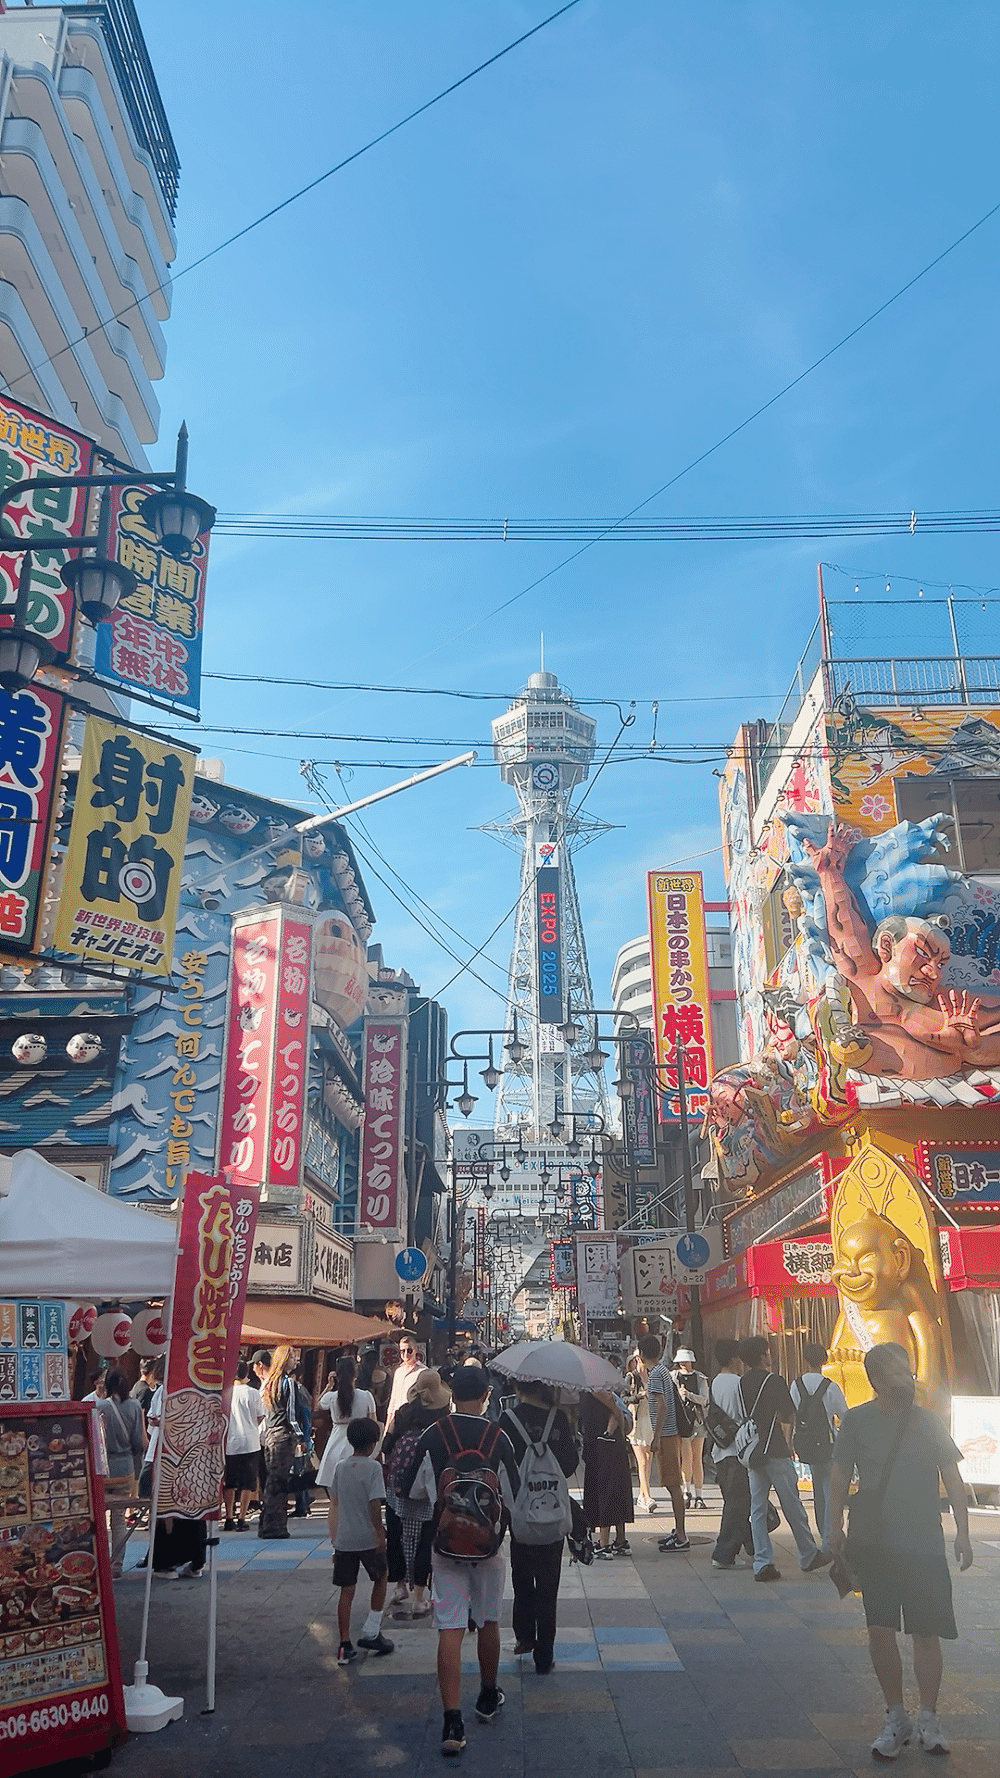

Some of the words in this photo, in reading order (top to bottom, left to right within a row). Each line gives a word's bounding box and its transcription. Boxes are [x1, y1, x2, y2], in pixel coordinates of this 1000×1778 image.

[80, 735, 186, 922] 射的
[75, 909, 165, 945] 新世界遊技場
[540, 892, 557, 944] EXPO
[70, 926, 164, 965] チャンピオン
[667, 893, 692, 1002] 日本一の串かつ
[542, 950, 558, 995] 2025
[663, 1004, 708, 1090] 横綱
[253, 1242, 293, 1268] 本店
[7, 1694, 109, 1739] 06-6630-8440
